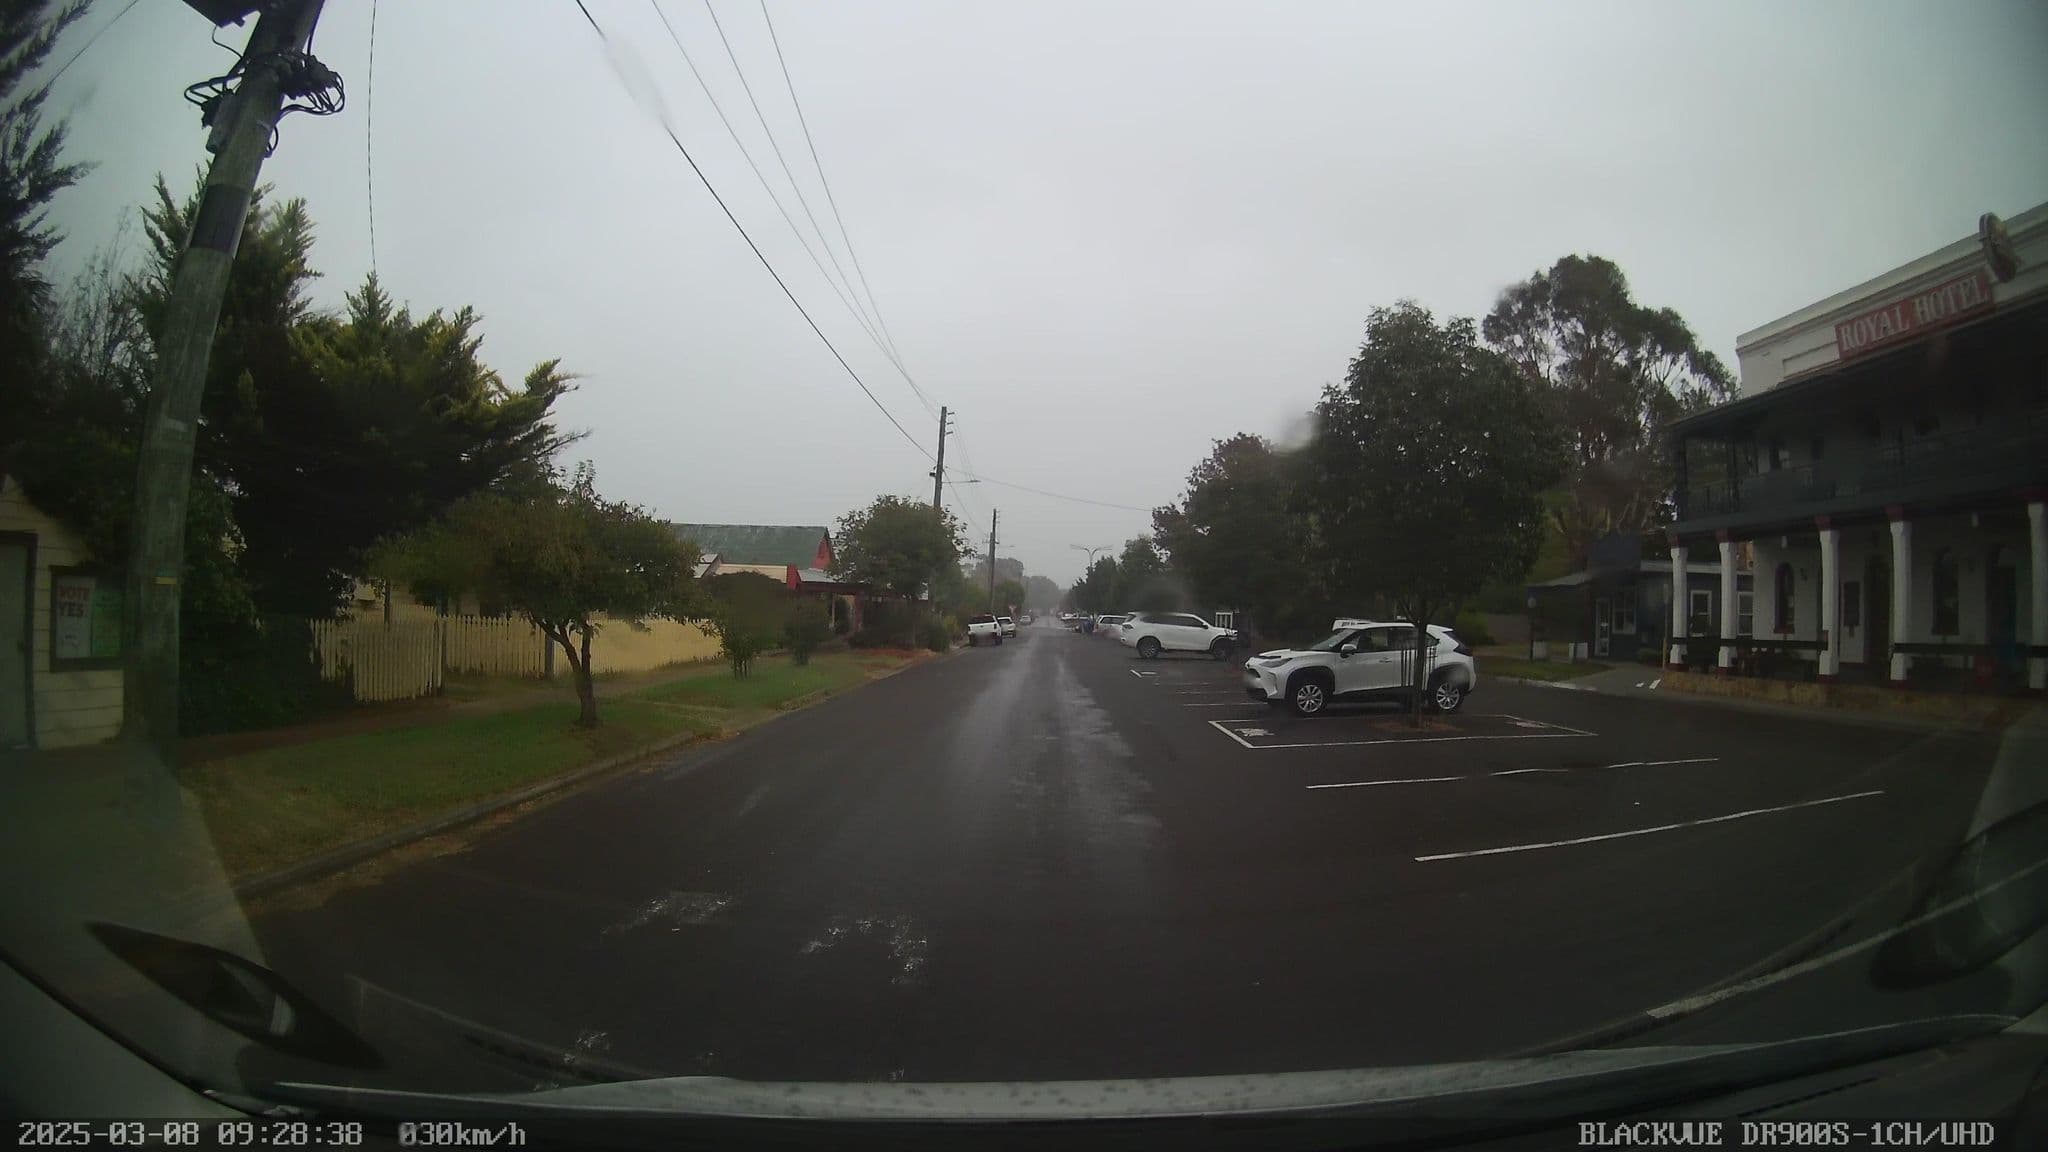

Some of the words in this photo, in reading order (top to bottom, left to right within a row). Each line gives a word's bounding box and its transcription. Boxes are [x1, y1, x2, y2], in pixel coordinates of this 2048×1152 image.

[1840, 303, 1910, 350] ROYAL
[1913, 275, 1989, 325] HOTEL
[58, 601, 85, 617] YES
